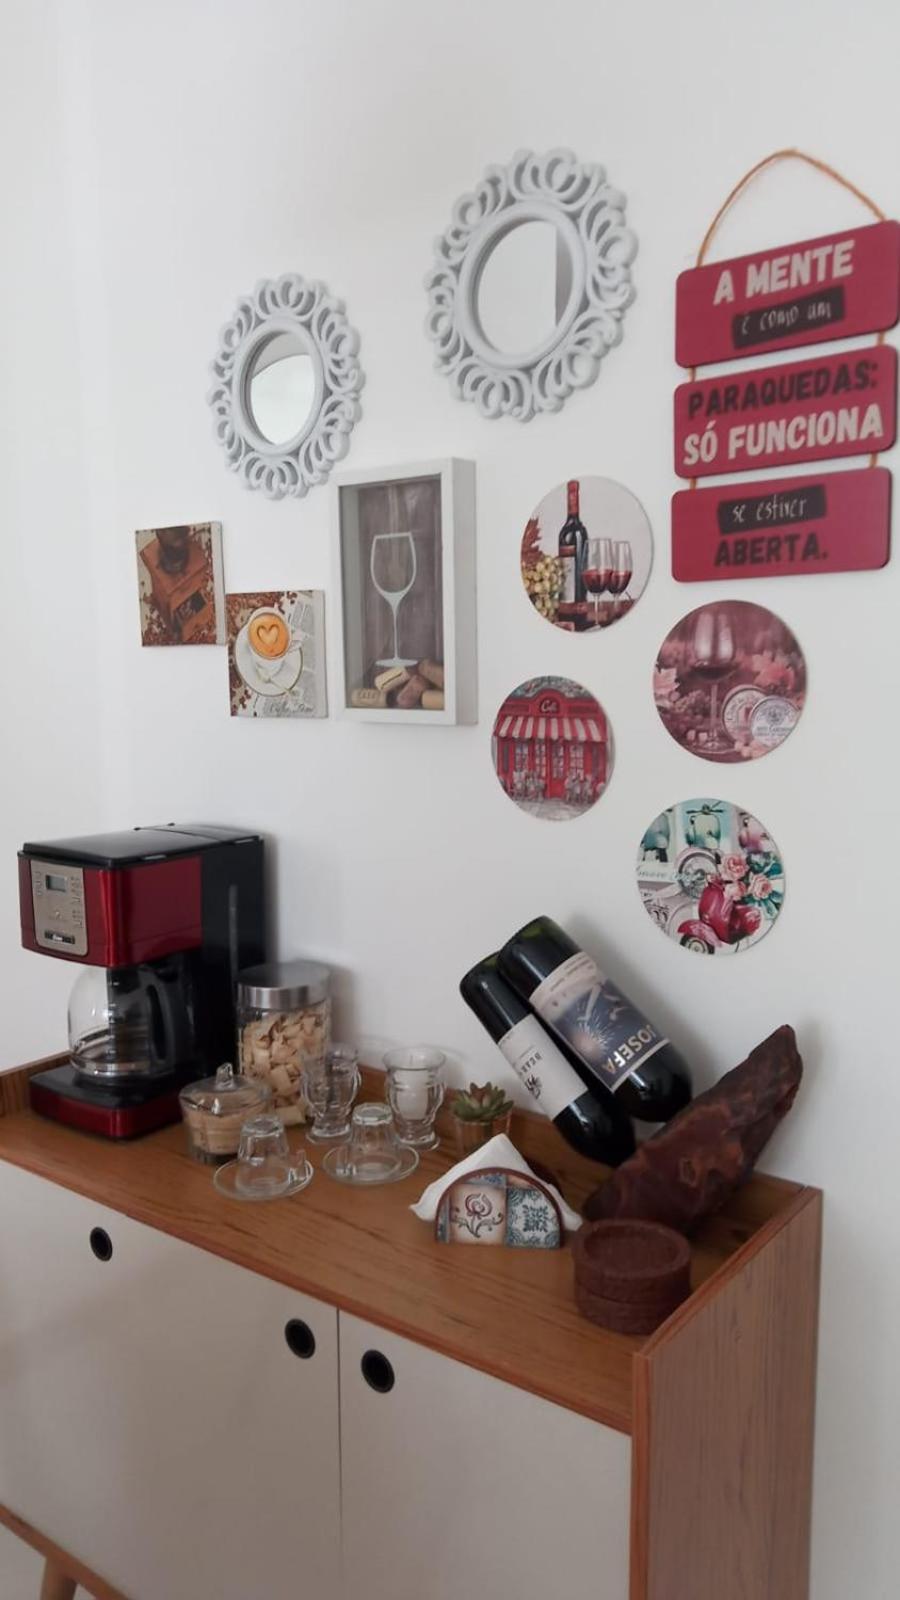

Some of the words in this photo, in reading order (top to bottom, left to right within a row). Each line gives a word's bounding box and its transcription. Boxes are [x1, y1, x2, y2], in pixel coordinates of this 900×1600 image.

[713, 270, 734, 305] A
[745, 240, 855, 298] MENTE
[759, 305, 799, 331] como
[807, 301, 832, 321] um
[688, 359, 879, 419] PARAQUEDAS:
[683, 419, 718, 467] SÓ
[728, 404, 883, 459] FUNCIONA
[732, 503, 746, 523] se
[756, 493, 807, 521] estiver
[714, 531, 828, 567] ABERTA.
[600, 1024, 657, 1075] JOSEFA
